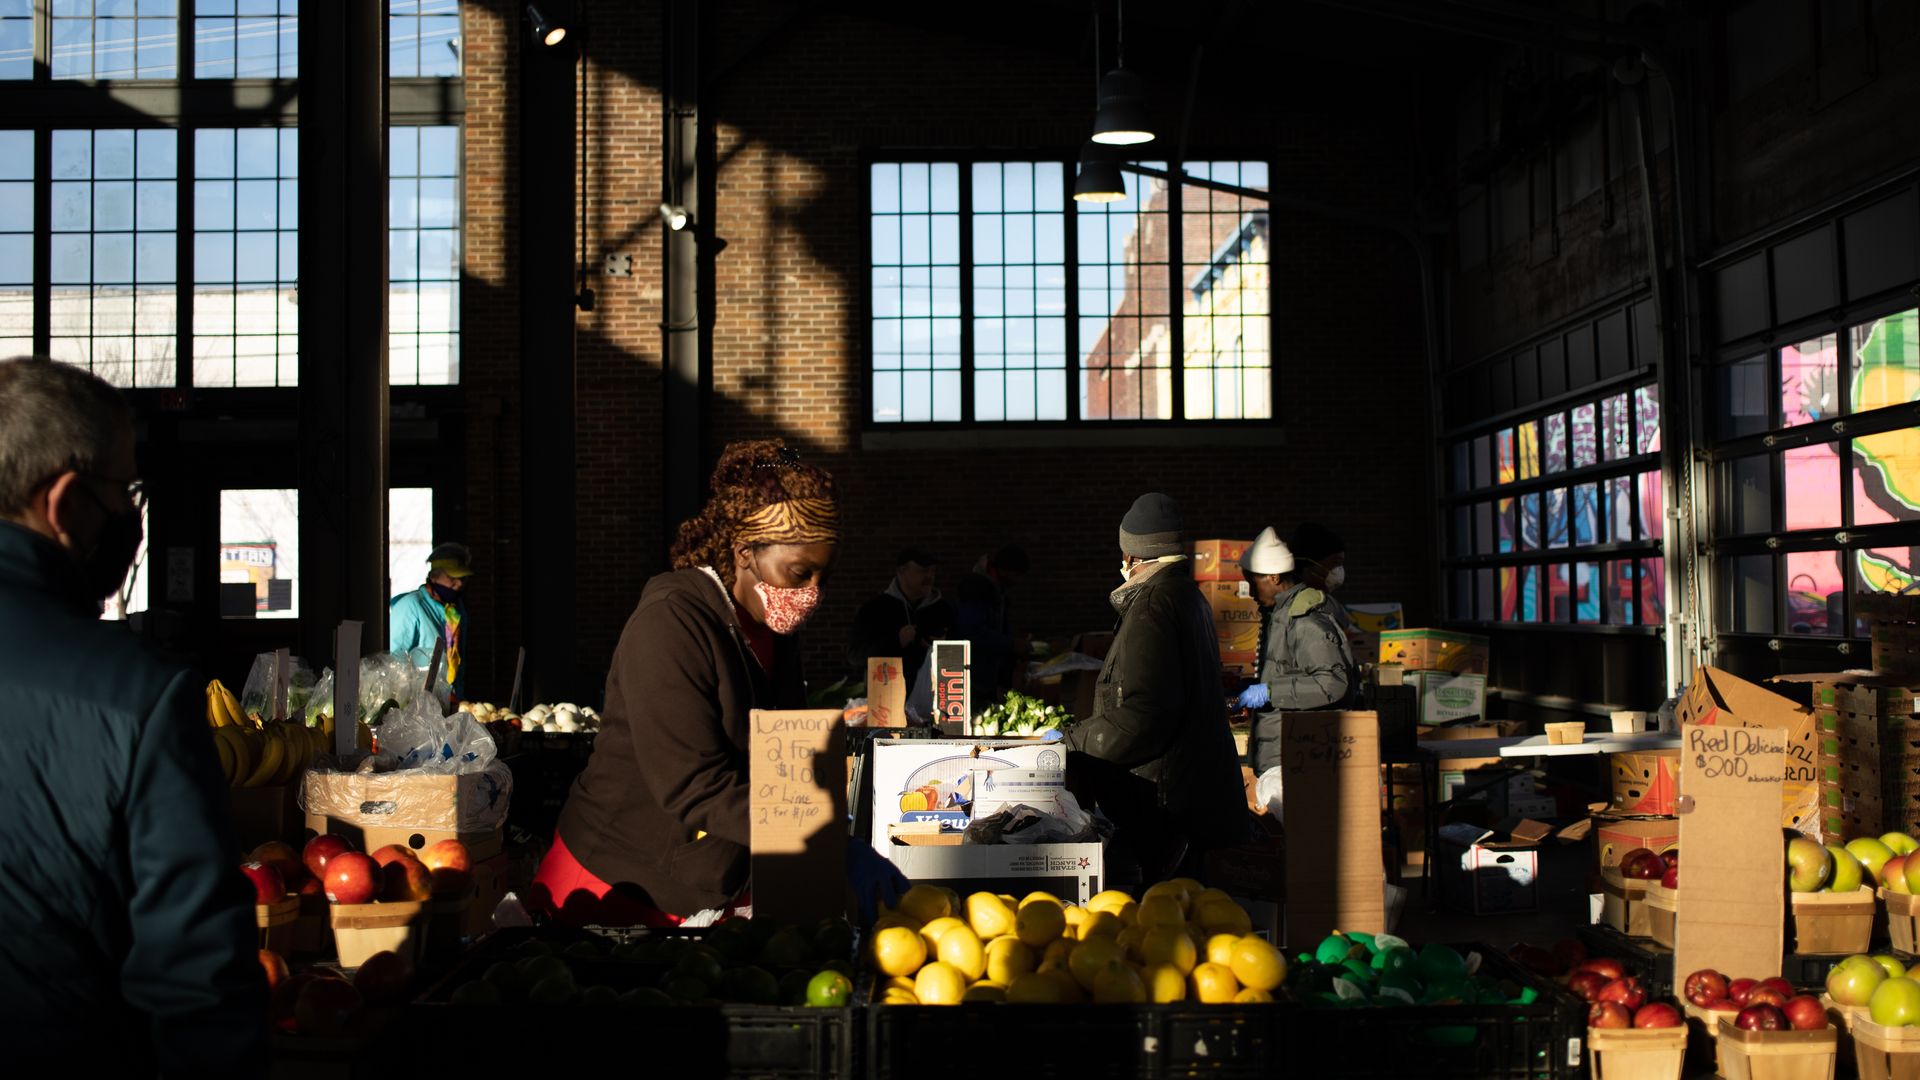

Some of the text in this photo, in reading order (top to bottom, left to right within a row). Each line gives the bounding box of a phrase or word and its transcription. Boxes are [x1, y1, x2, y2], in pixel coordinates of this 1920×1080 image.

[939, 681, 947, 710] apples
[756, 713, 834, 735] Lemon
[766, 736, 783, 761] 2
[1690, 728, 1729, 753] Red
[1290, 750, 1305, 775] 2
[759, 807, 768, 825] 2
